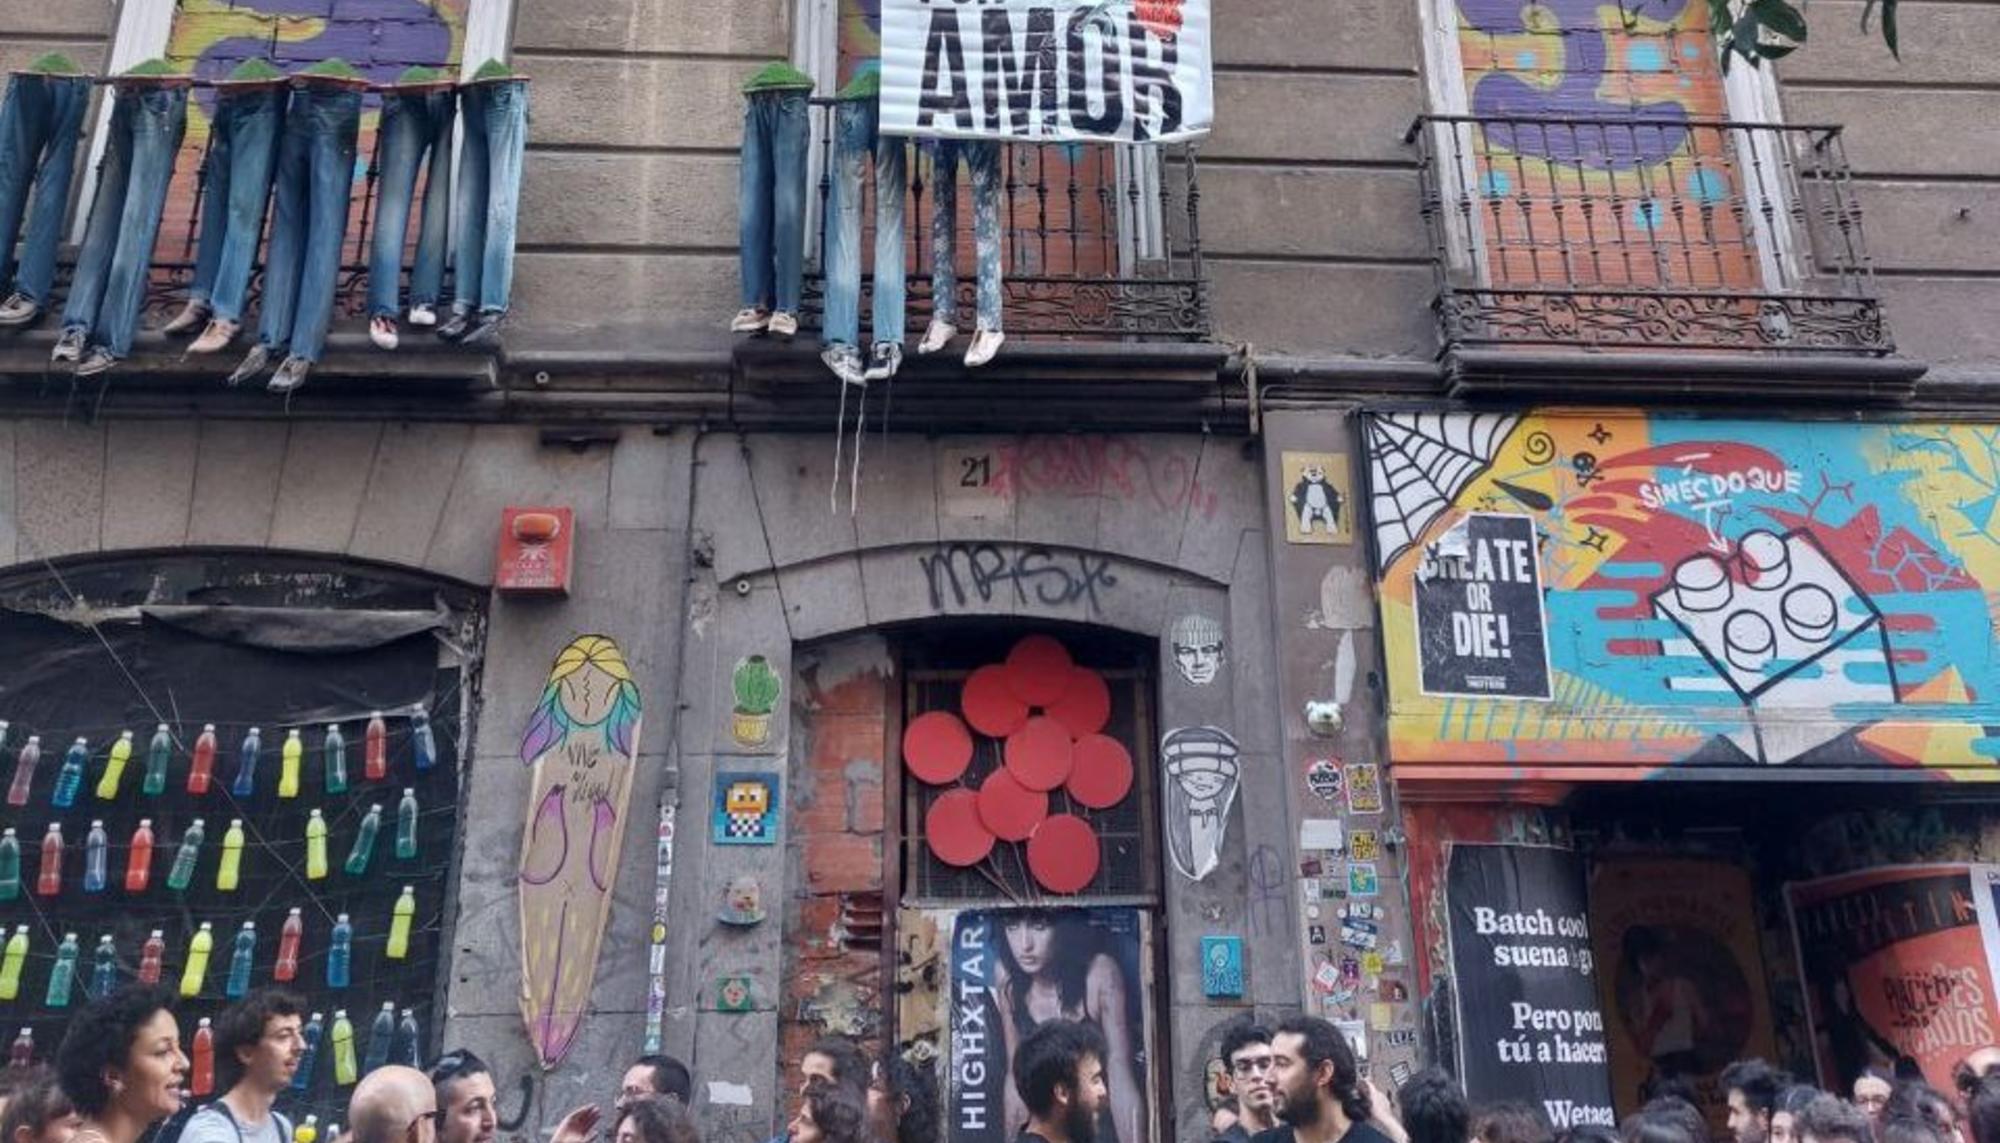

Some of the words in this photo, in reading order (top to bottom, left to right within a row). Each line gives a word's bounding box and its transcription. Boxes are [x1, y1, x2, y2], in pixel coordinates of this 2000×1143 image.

[916, 7, 1183, 141] AMOR
[960, 456, 991, 487] 21
[1466, 582, 1493, 611] OR
[1451, 611, 1512, 658] DIE!
[1473, 906, 1555, 936] Batch
[1494, 944, 1569, 967] suena
[1510, 1002, 1572, 1031] Pero
[1497, 1034, 1532, 1062] tú
[1537, 1042, 1551, 1063] a
